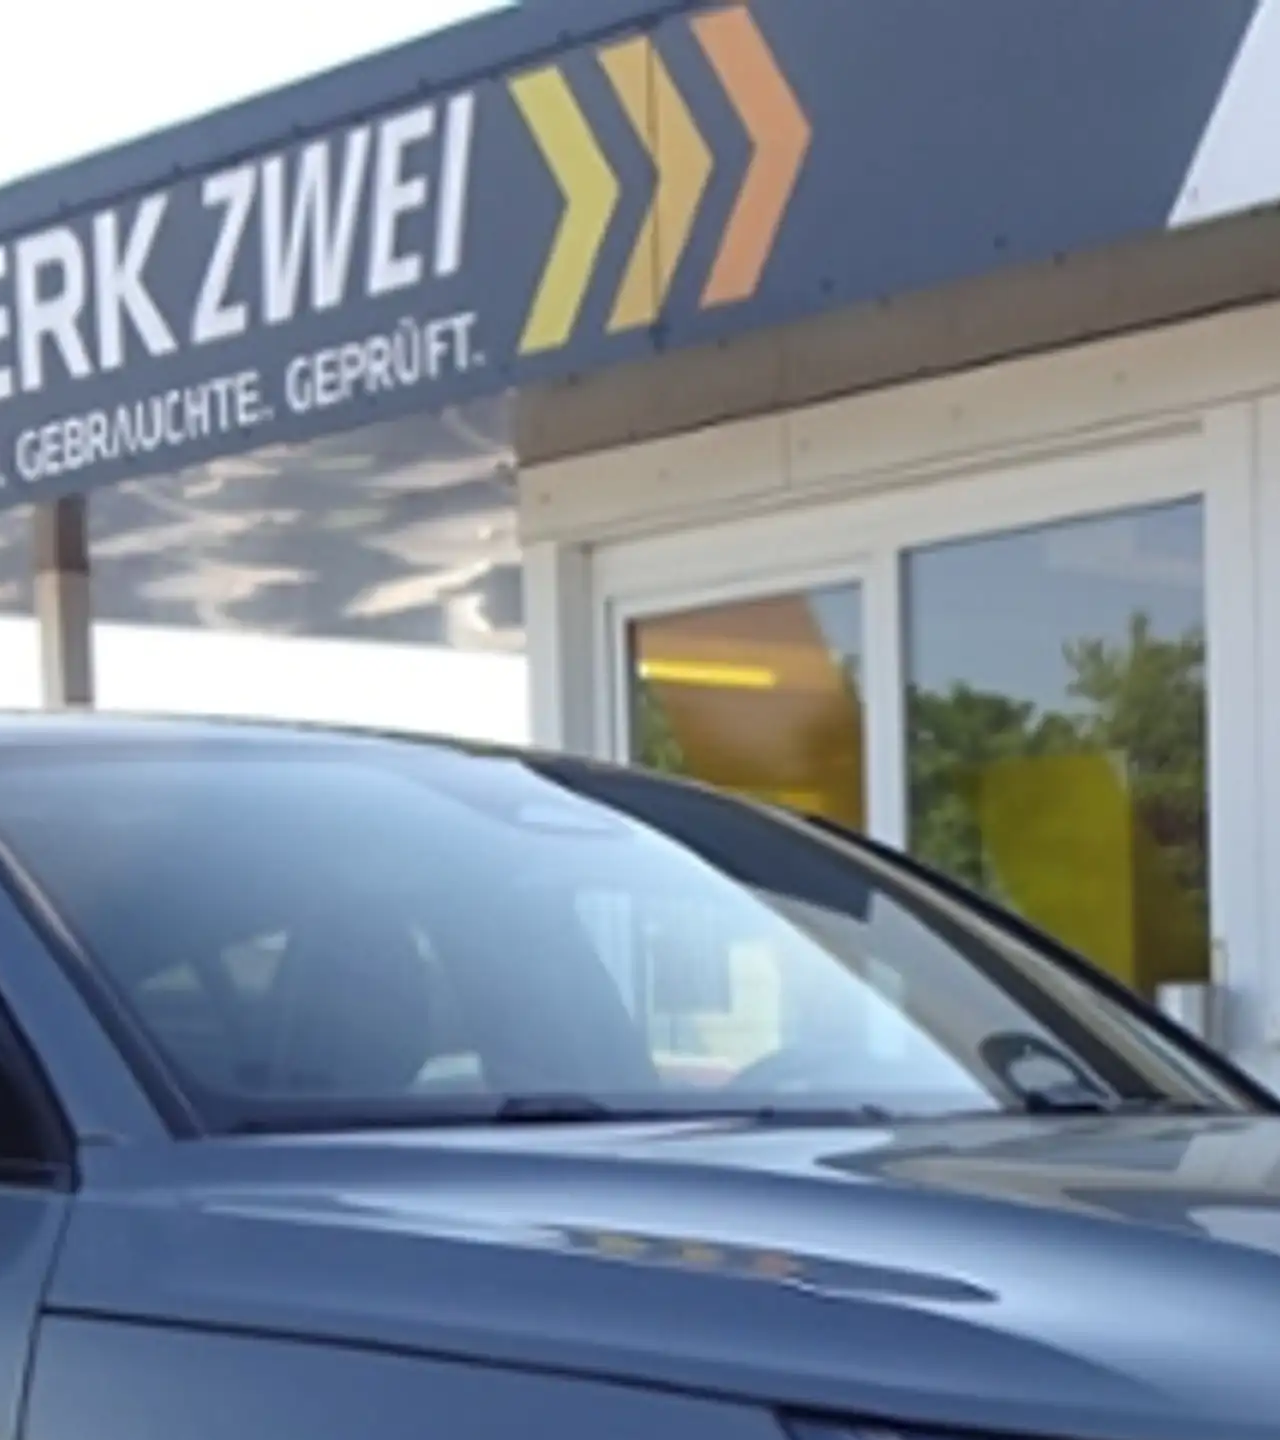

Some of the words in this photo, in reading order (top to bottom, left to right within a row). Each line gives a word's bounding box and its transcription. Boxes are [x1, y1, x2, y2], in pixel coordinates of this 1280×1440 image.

[191, 92, 474, 345] ZWEI
[16, 369, 274, 482] GEBRAUCHTE.
[284, 311, 486, 413] GEPRÜFT.
